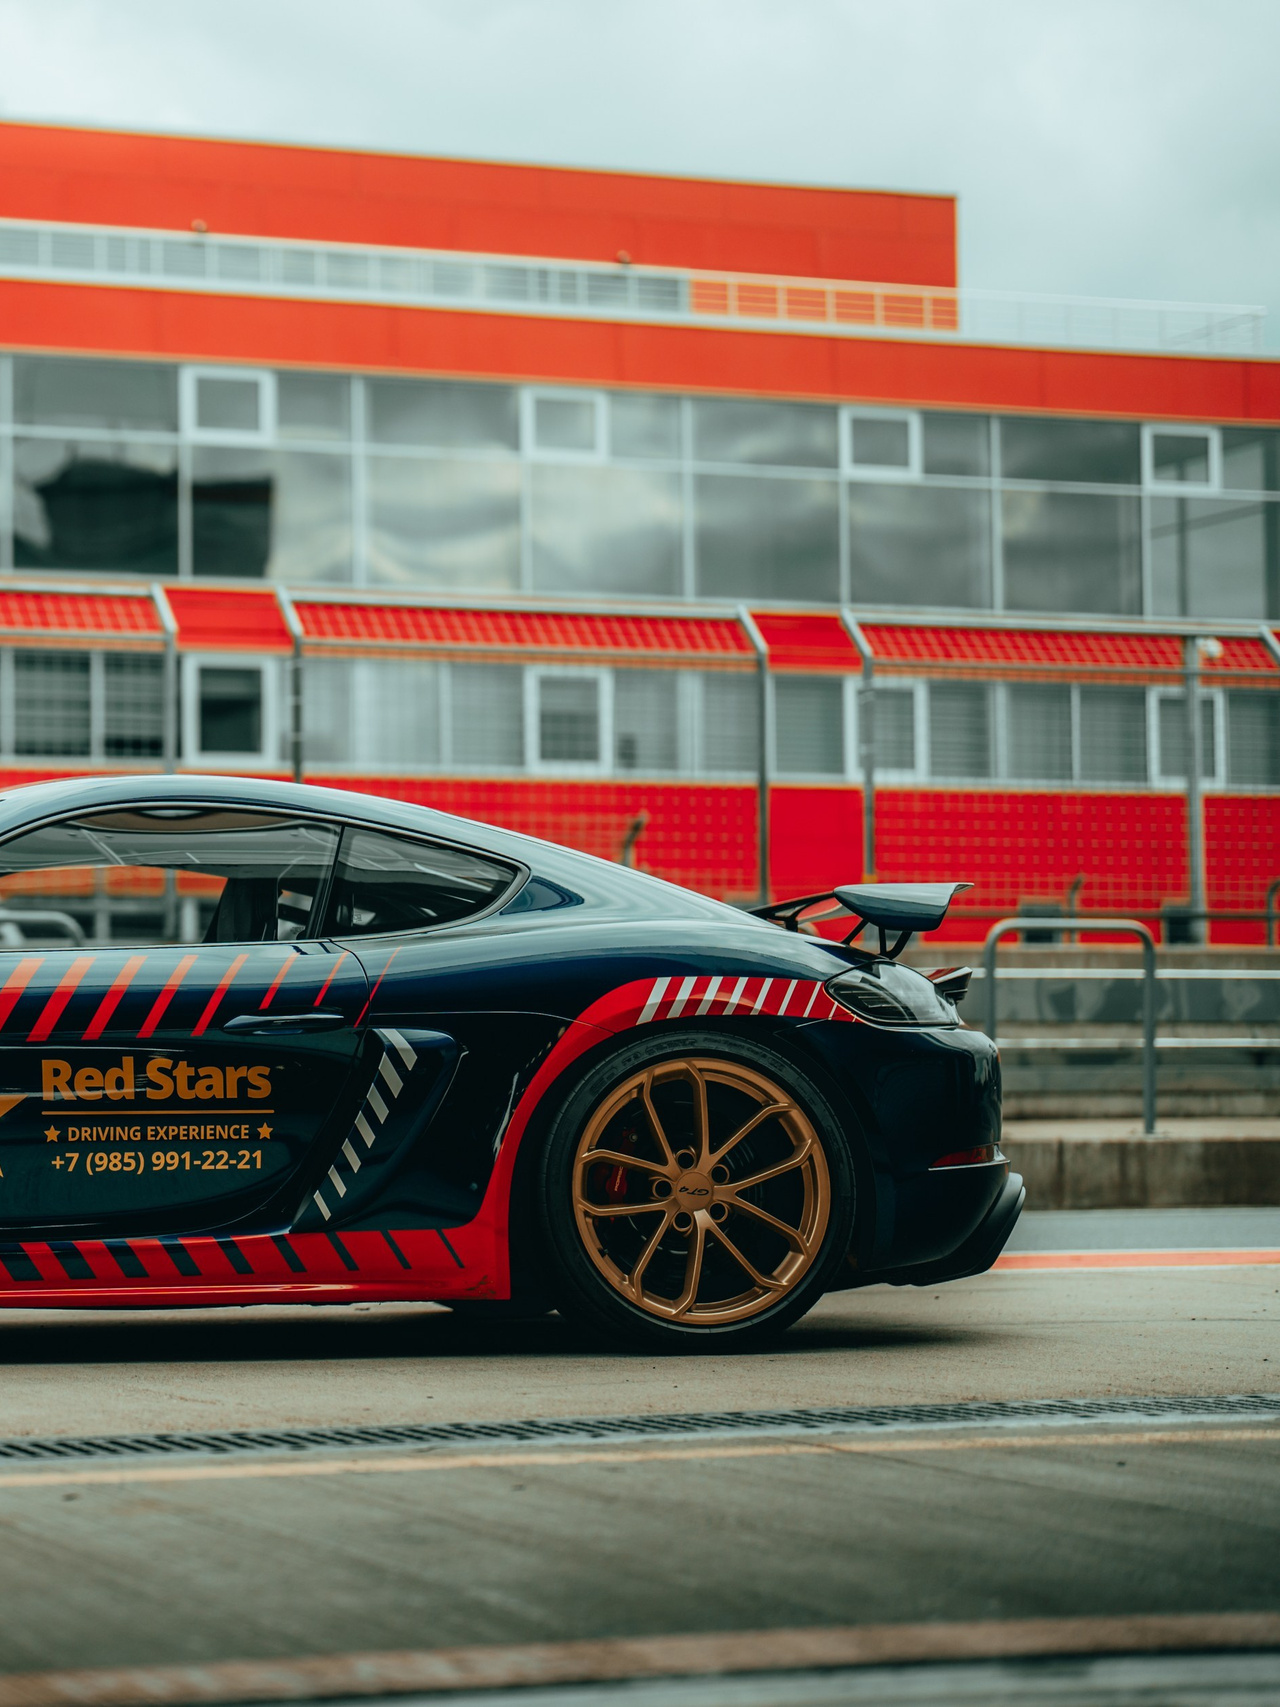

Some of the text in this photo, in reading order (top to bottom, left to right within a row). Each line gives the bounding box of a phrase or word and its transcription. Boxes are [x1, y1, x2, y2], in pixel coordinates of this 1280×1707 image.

[41, 1056, 272, 1101] Red Stars
[67, 1124, 250, 1142] DRIVING EXPERIENCE
[51, 1149, 262, 1176] +7 (985) 991-22-21
[678, 1185, 710, 1196] GT4
